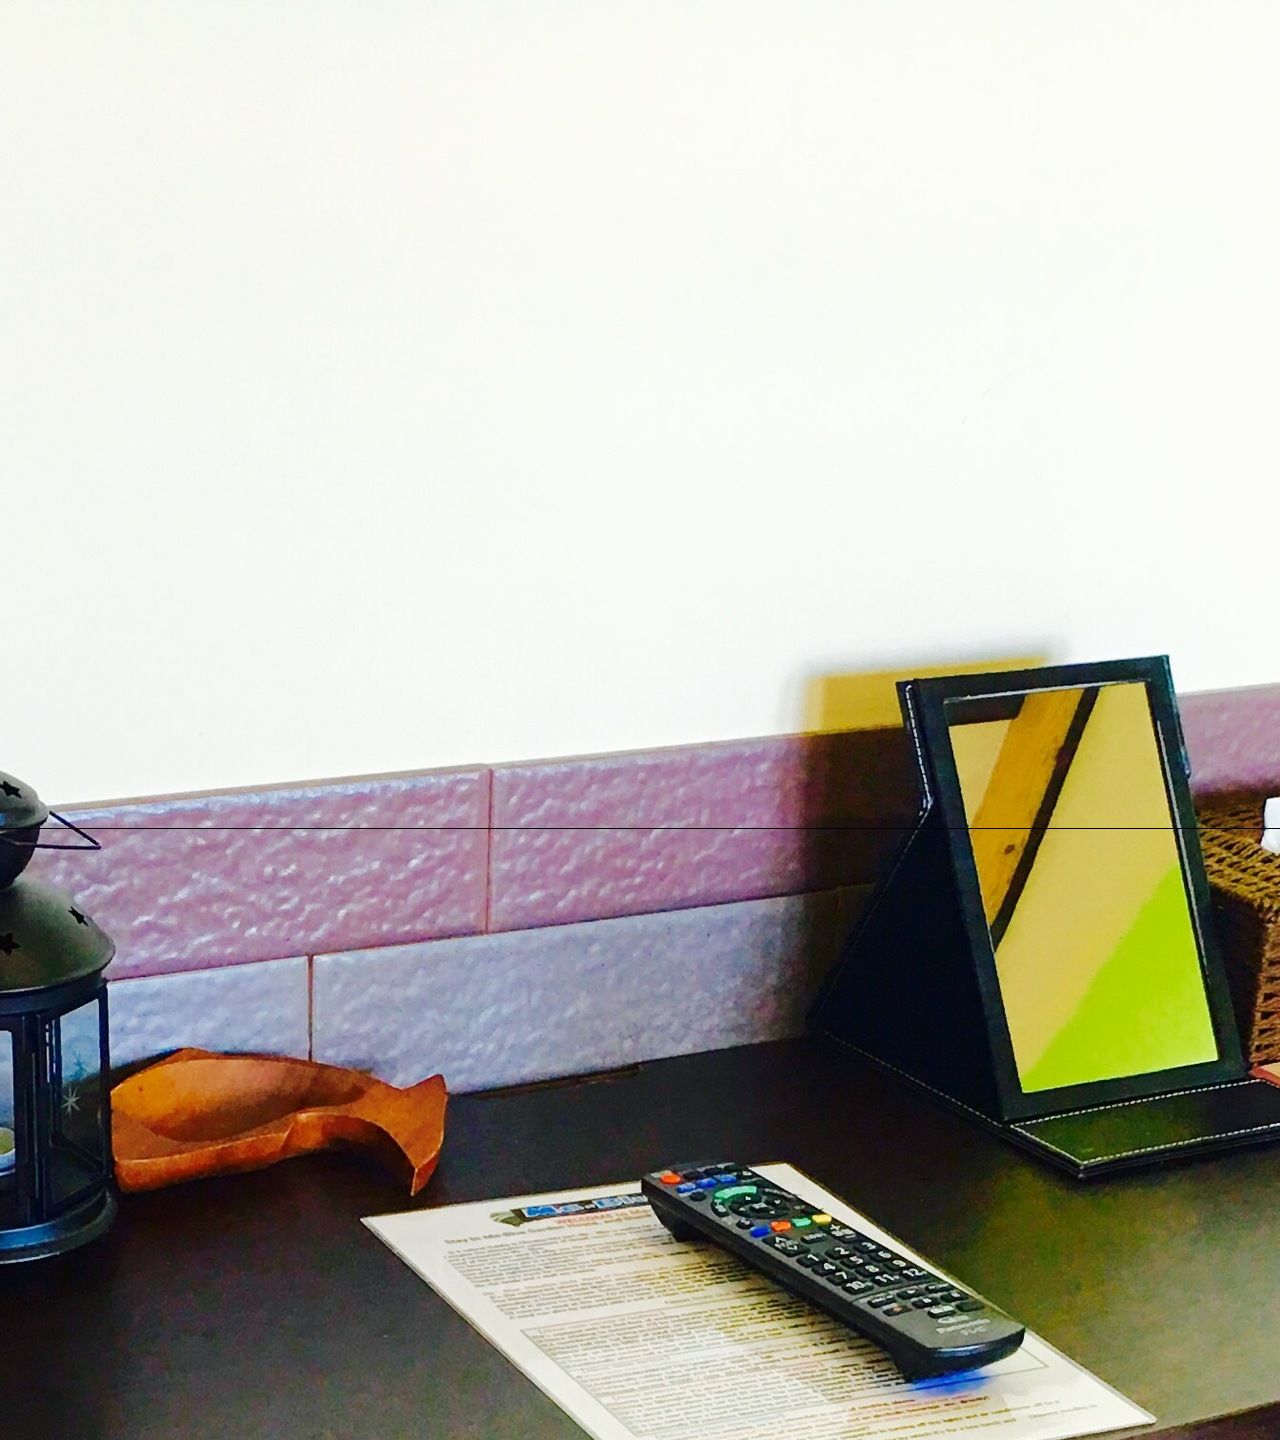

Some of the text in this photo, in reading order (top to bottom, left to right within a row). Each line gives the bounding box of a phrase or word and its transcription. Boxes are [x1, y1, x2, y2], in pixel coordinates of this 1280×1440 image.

[807, 1241, 876, 1261] 1 2 3
[823, 1250, 891, 1270] 4 5 6
[835, 1271, 847, 1279] 7
[865, 1264, 879, 1272] 8
[846, 1268, 921, 1290] 10 11 12
